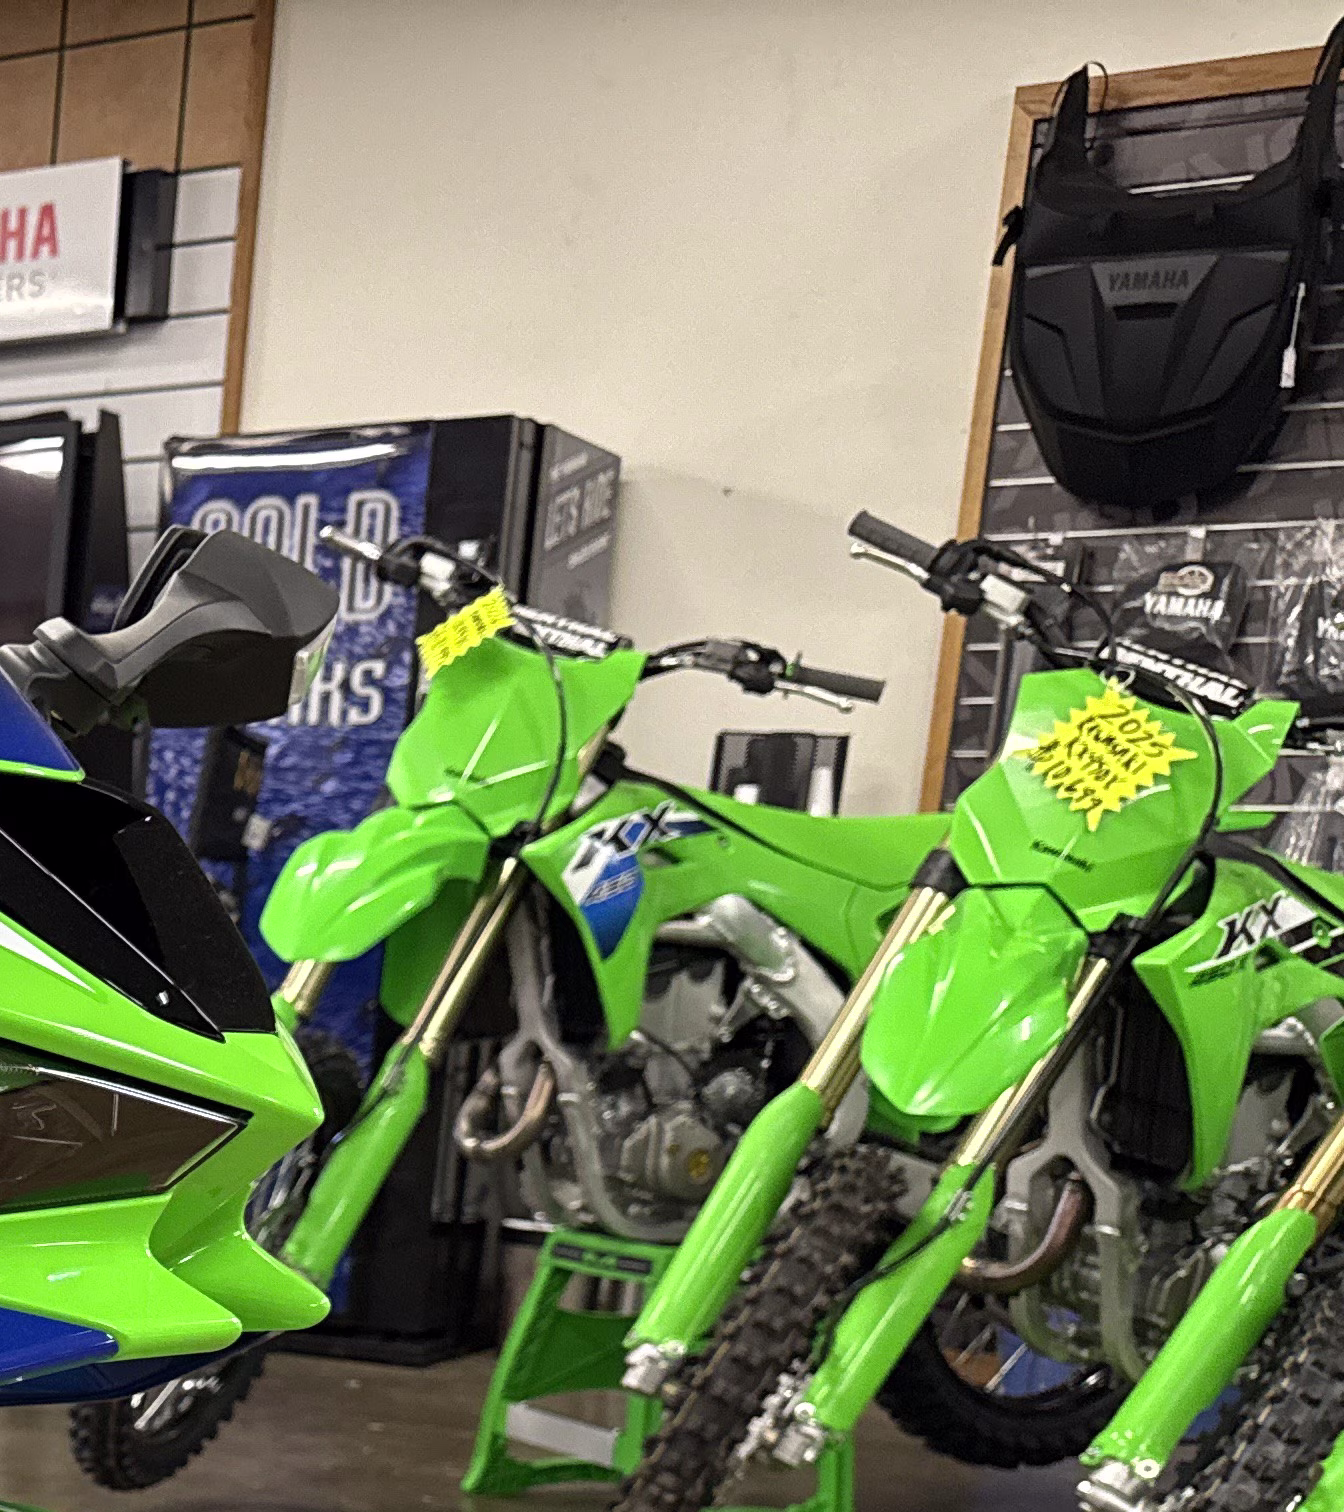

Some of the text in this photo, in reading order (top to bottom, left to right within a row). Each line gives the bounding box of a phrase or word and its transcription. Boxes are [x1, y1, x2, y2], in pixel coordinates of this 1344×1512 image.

[1107, 268, 1190, 294] YAMAHA
[1143, 592, 1225, 623] YAMAHA
[1097, 703, 1170, 759] 2025
[1214, 893, 1284, 960] KX
